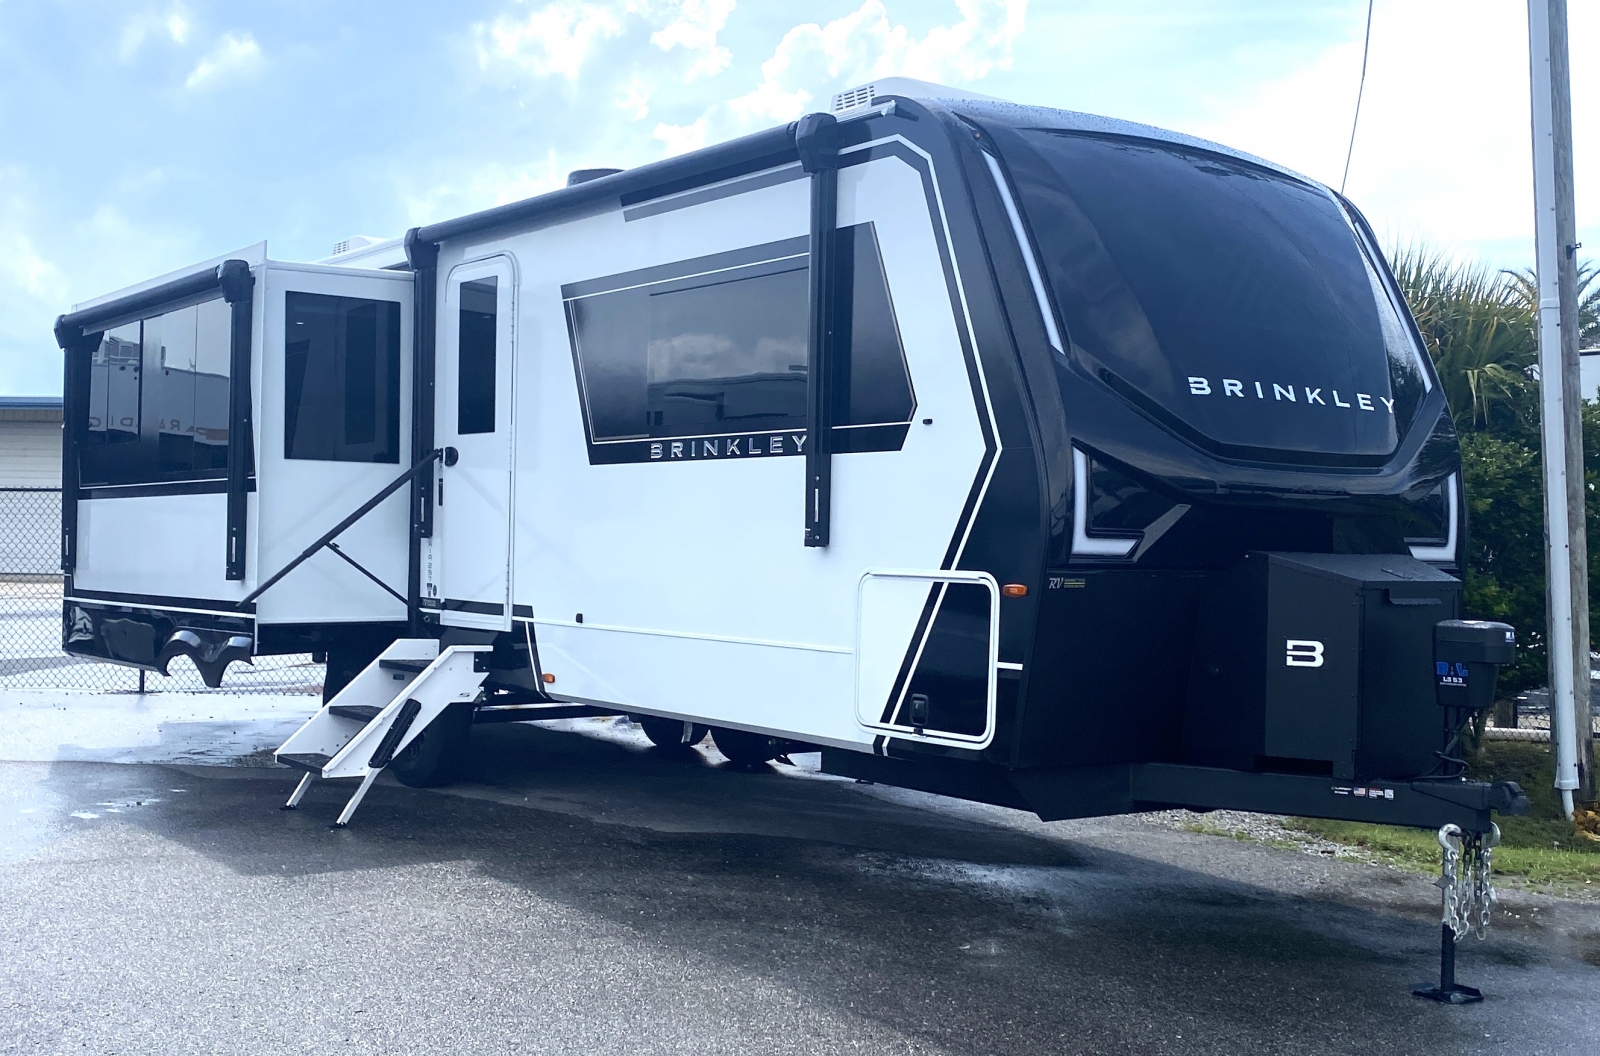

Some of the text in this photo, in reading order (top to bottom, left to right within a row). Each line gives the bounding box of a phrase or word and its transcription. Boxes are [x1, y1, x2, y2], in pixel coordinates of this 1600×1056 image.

[1188, 377, 1394, 413] BRINKLEY
[650, 435, 807, 459] BRINKLEY
[1049, 577, 1063, 589] RV
[1286, 640, 1324, 667] B
